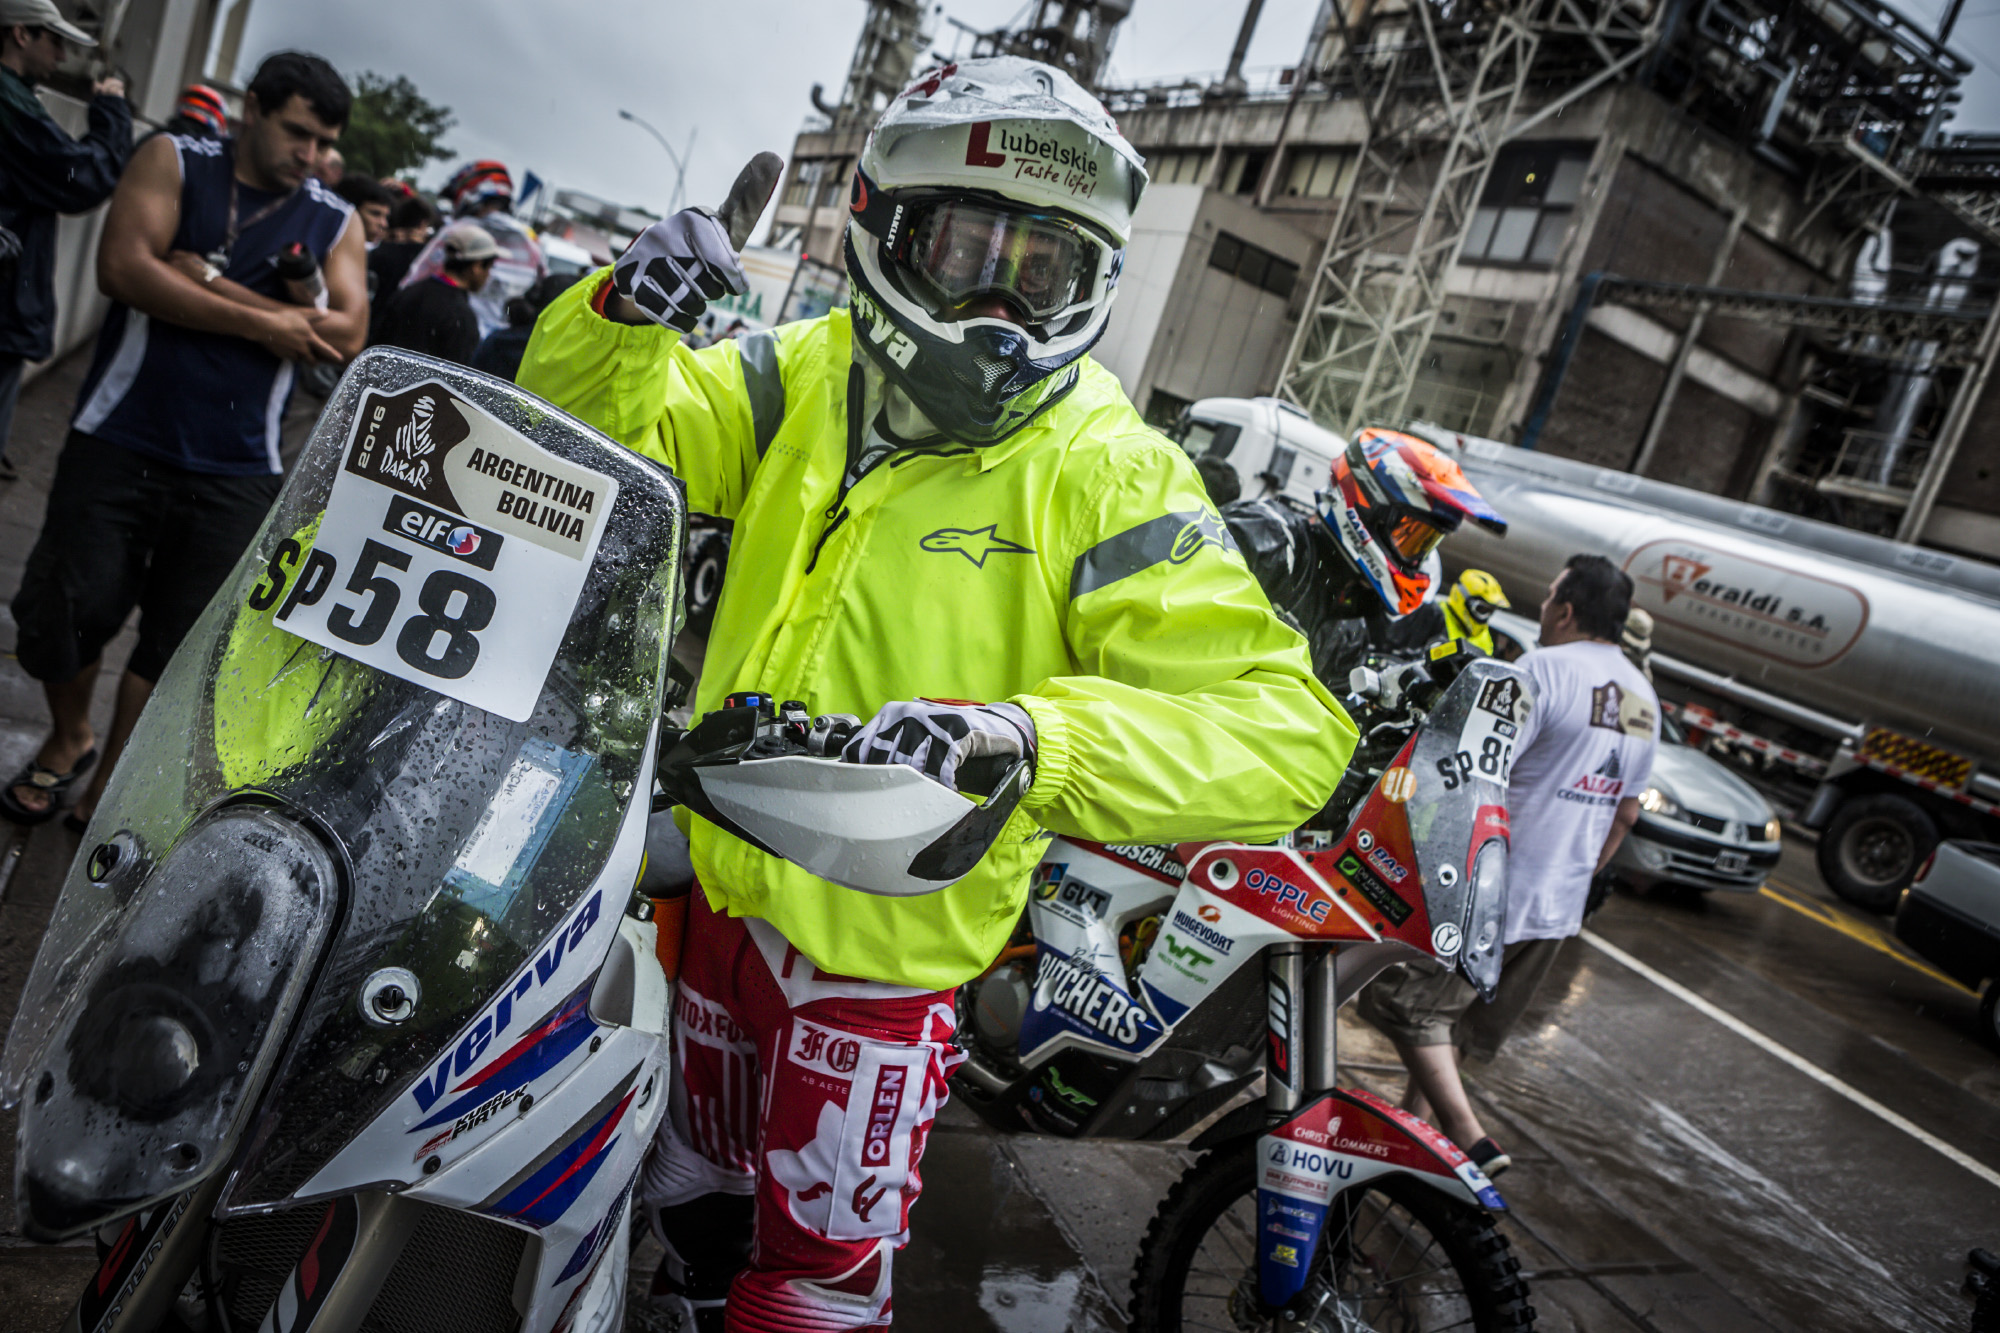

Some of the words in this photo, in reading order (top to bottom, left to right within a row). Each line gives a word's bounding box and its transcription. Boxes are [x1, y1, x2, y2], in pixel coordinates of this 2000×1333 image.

[1014, 157, 1060, 183] Taste
[1063, 169, 1097, 199] life!
[886, 204, 903, 250] OAKLEY
[846, 274, 918, 370] erva
[357, 405, 386, 469] 2016
[380, 445, 429, 490] DAKAR
[466, 447, 595, 513] ARGENTINA
[400, 510, 448, 542] elf
[496, 490, 585, 542] BOLIVIA
[1373, 848, 1408, 879] BAS
[1245, 868, 1332, 924] OPPLE
[1271, 904, 1318, 933] LIGHTING
[1174, 909, 1235, 951] HUIGEVOORT
[411, 889, 602, 1114] verva
[1033, 951, 1148, 1045] BUTCHERS
[802, 1075, 815, 1086] AB
[819, 1080, 848, 1095] AETE
[456, 1090, 506, 1128] KUBA
[867, 1069, 903, 1162] ORLEN
[1292, 1149, 1354, 1180] HOVU
[1294, 1126, 1331, 1144] CHRIST
[1333, 1136, 1390, 1158] LOMMERS
